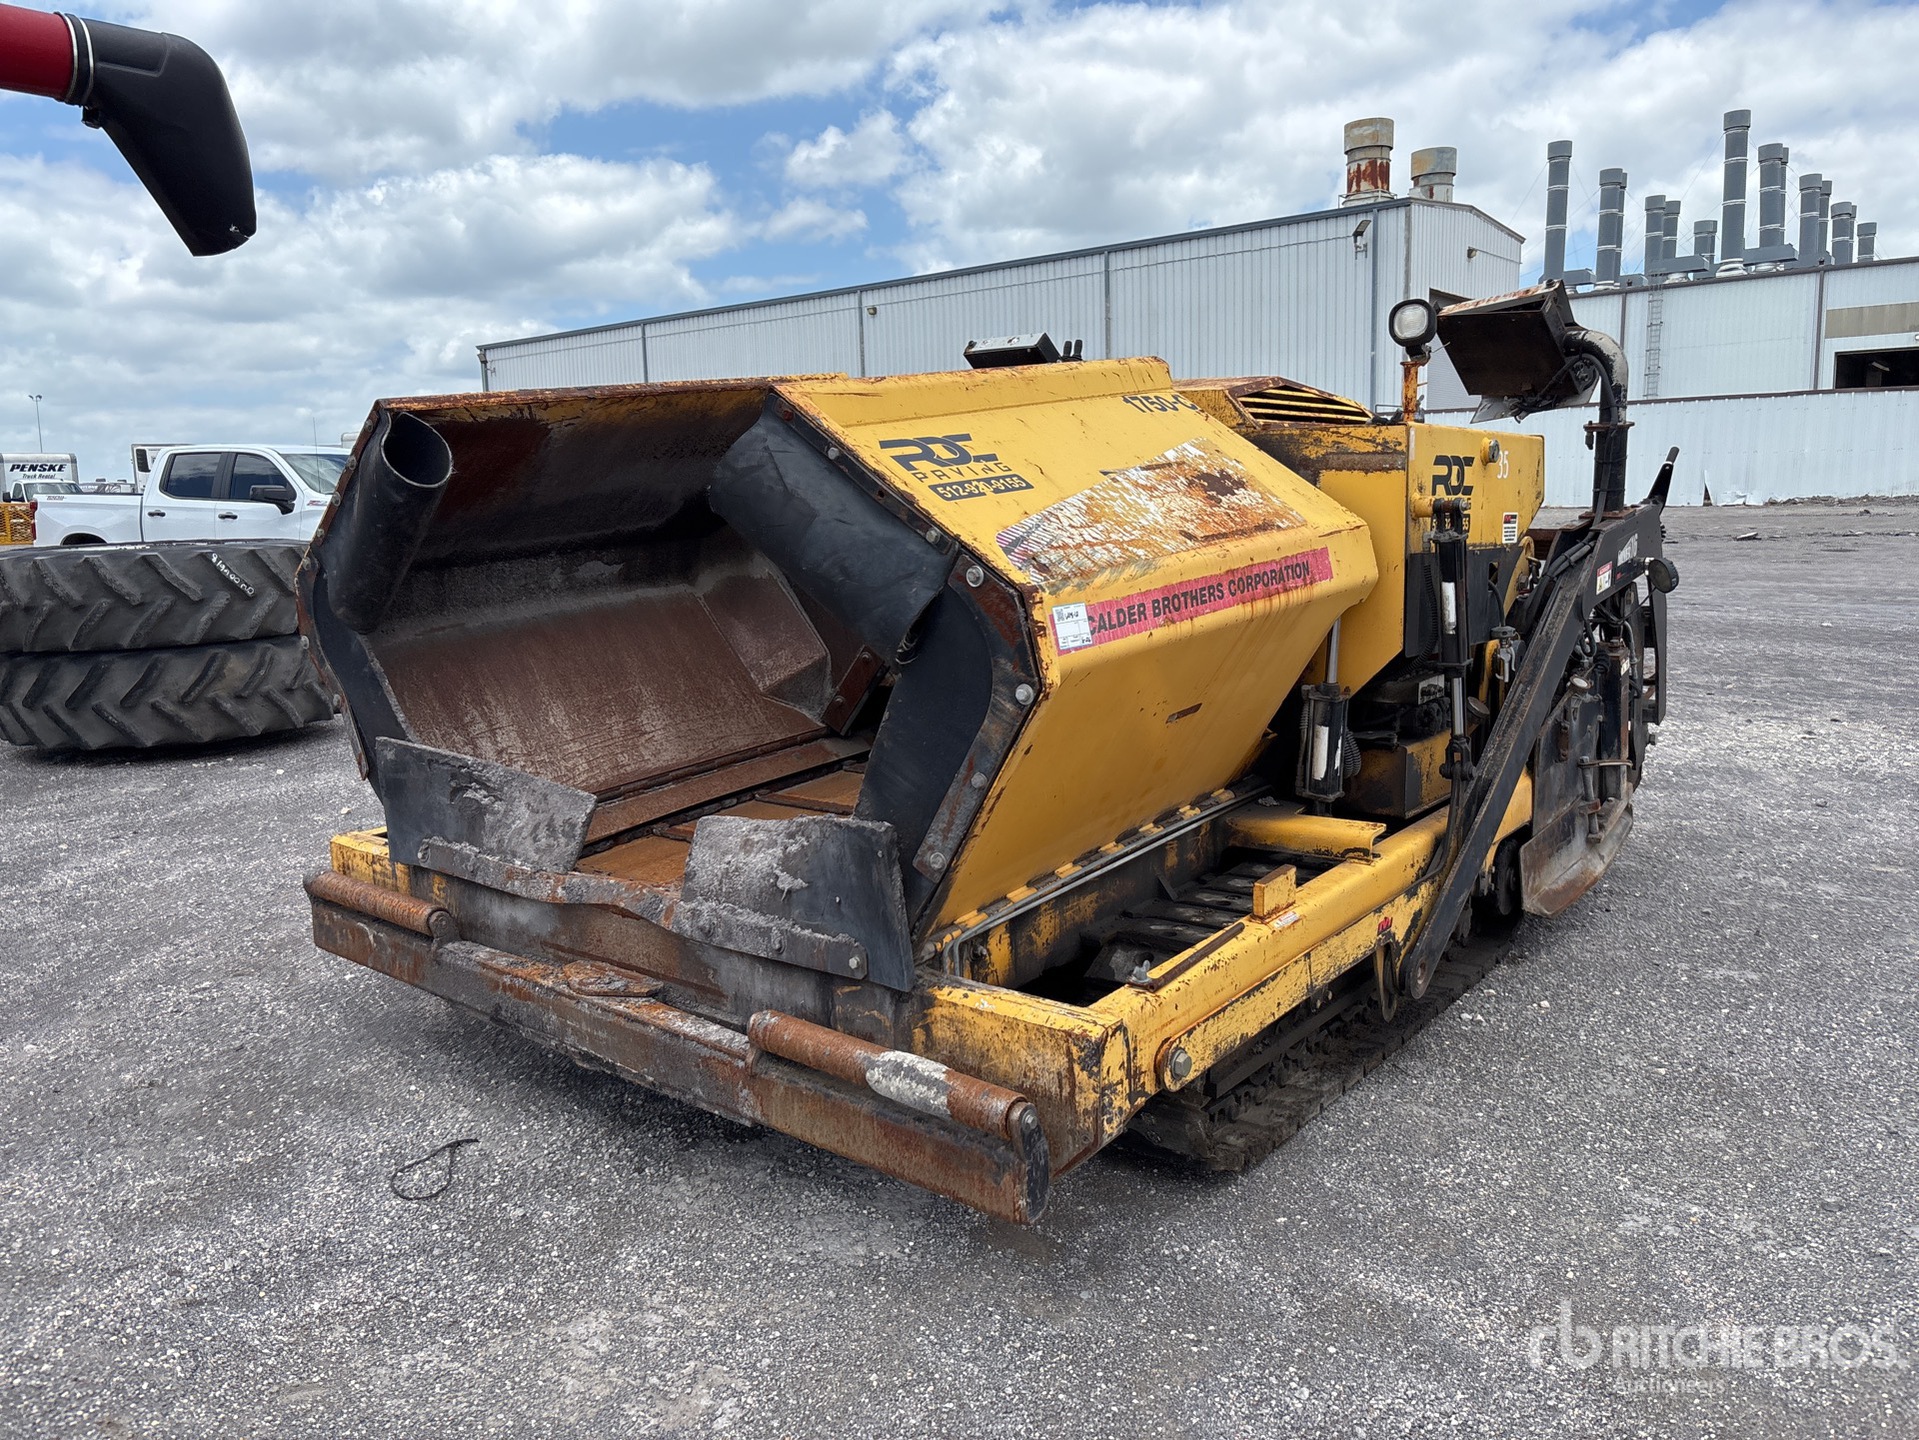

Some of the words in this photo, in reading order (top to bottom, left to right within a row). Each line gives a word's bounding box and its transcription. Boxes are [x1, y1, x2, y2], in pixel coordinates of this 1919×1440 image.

[1122, 394, 1198, 413] 1750-C
[10, 464, 67, 472] PENSKE
[911, 461, 1013, 484] PAVING
[1431, 455, 1475, 496] RDC
[1497, 450, 1508, 479] 35
[1088, 602, 1147, 636] CALDER
[1152, 582, 1224, 618] BROTHERS
[1228, 560, 1311, 597] CORPORATION
